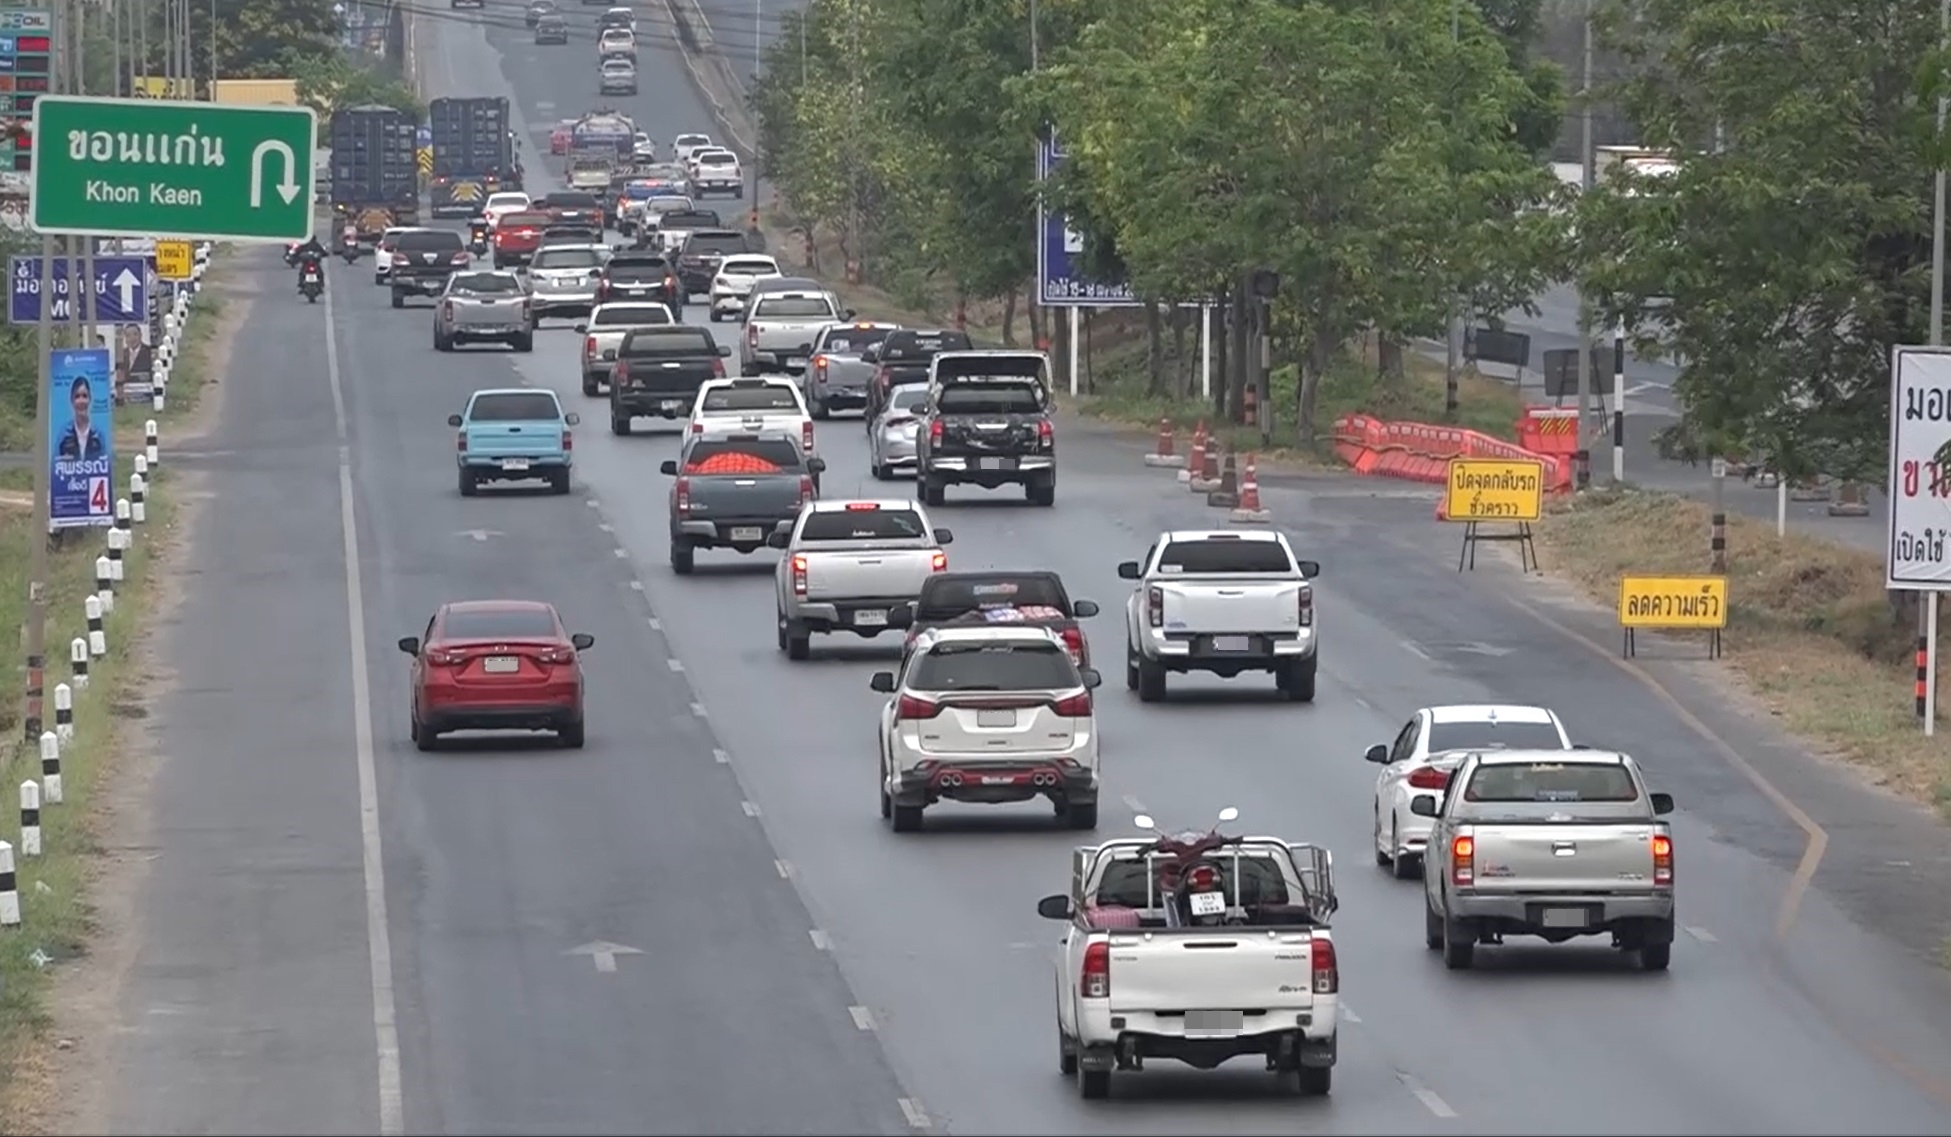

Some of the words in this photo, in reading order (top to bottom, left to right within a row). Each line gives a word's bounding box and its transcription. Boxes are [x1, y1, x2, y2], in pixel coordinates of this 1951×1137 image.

[67, 123, 226, 167] ขอนแก่น
[86, 180, 140, 204] Khon
[150, 183, 203, 207] Kaen
[1456, 464, 1536, 493] ปิดจุดกลับรถ
[91, 479, 107, 511] 4
[1470, 493, 1519, 516] ชั่วคราว
[1896, 529, 1946, 563] เปิดใช้
[1627, 584, 1719, 616] ลดความเร็ว
